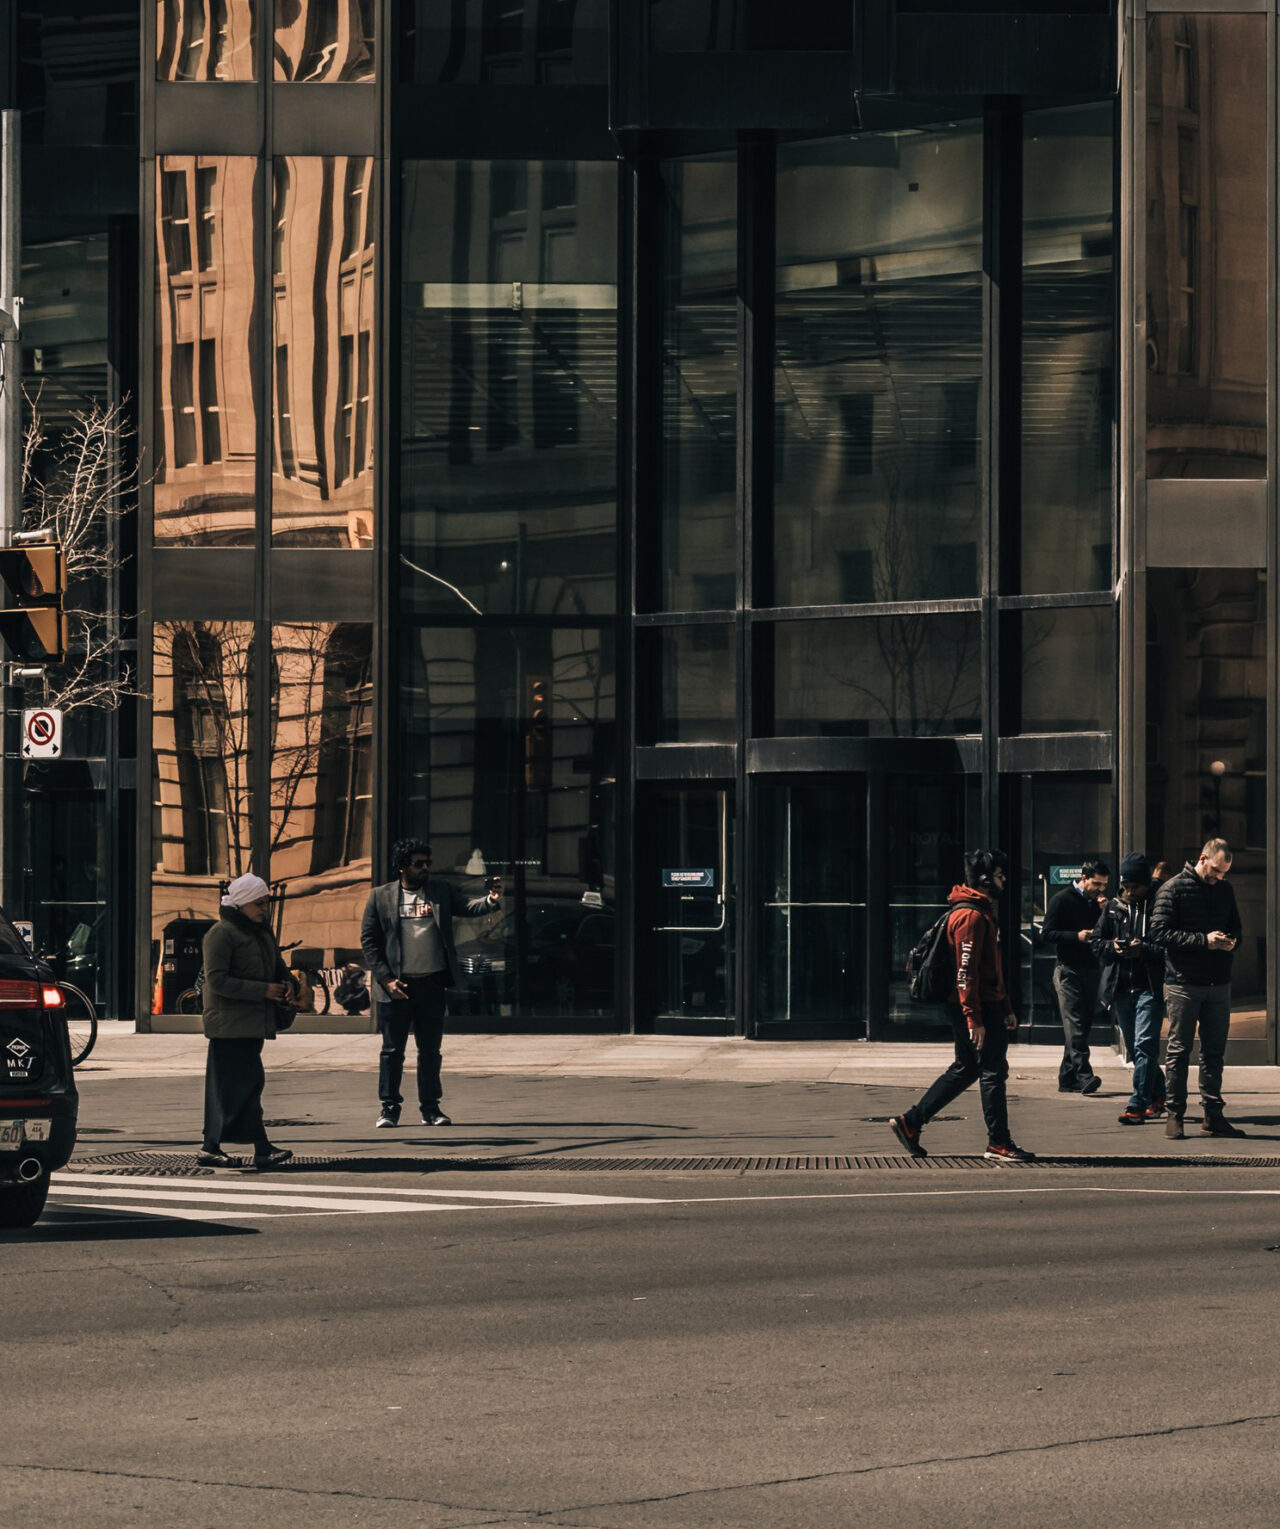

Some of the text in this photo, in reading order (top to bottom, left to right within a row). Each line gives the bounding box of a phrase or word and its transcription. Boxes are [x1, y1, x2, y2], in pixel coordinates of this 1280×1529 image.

[956, 941, 974, 990] JUST DO IT.
[7, 1056, 37, 1069] MKT
